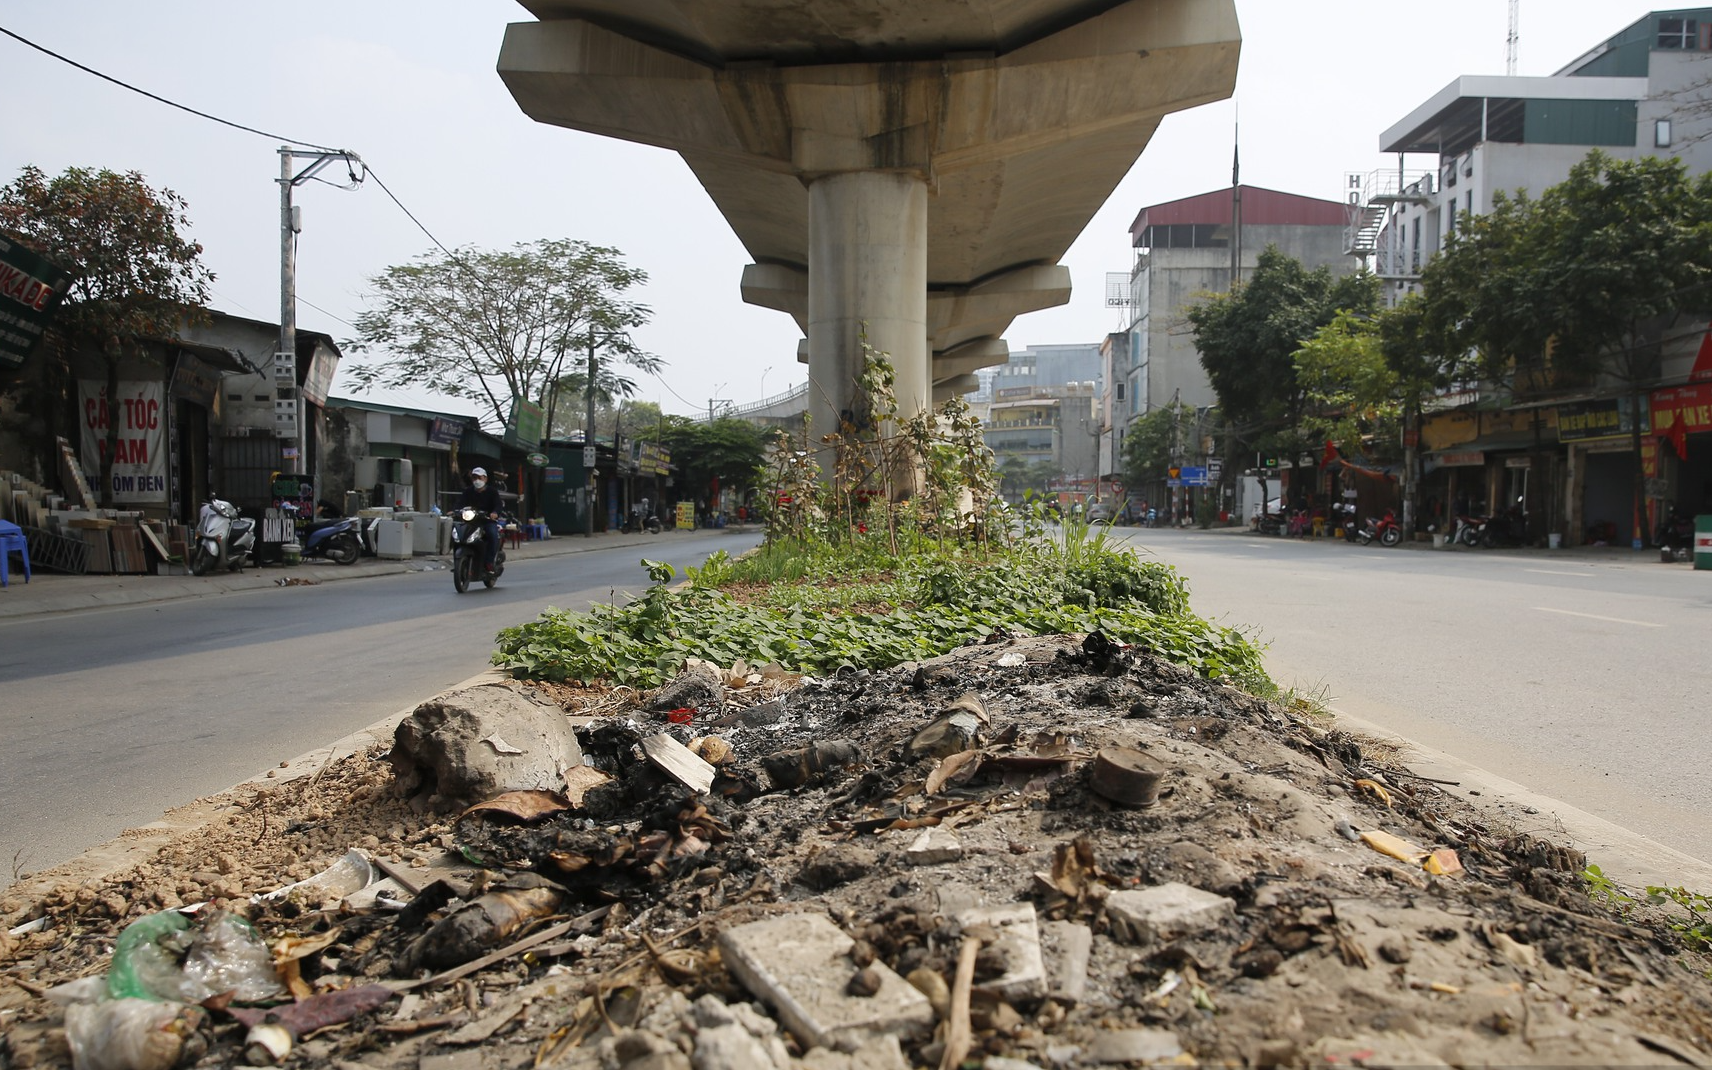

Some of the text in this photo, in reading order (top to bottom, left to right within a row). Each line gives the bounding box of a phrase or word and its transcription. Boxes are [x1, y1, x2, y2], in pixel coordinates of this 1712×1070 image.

[0, 261, 54, 313] IKADO
[86, 386, 158, 430] CẮ TÓC
[138, 475, 164, 492] ĐEN
